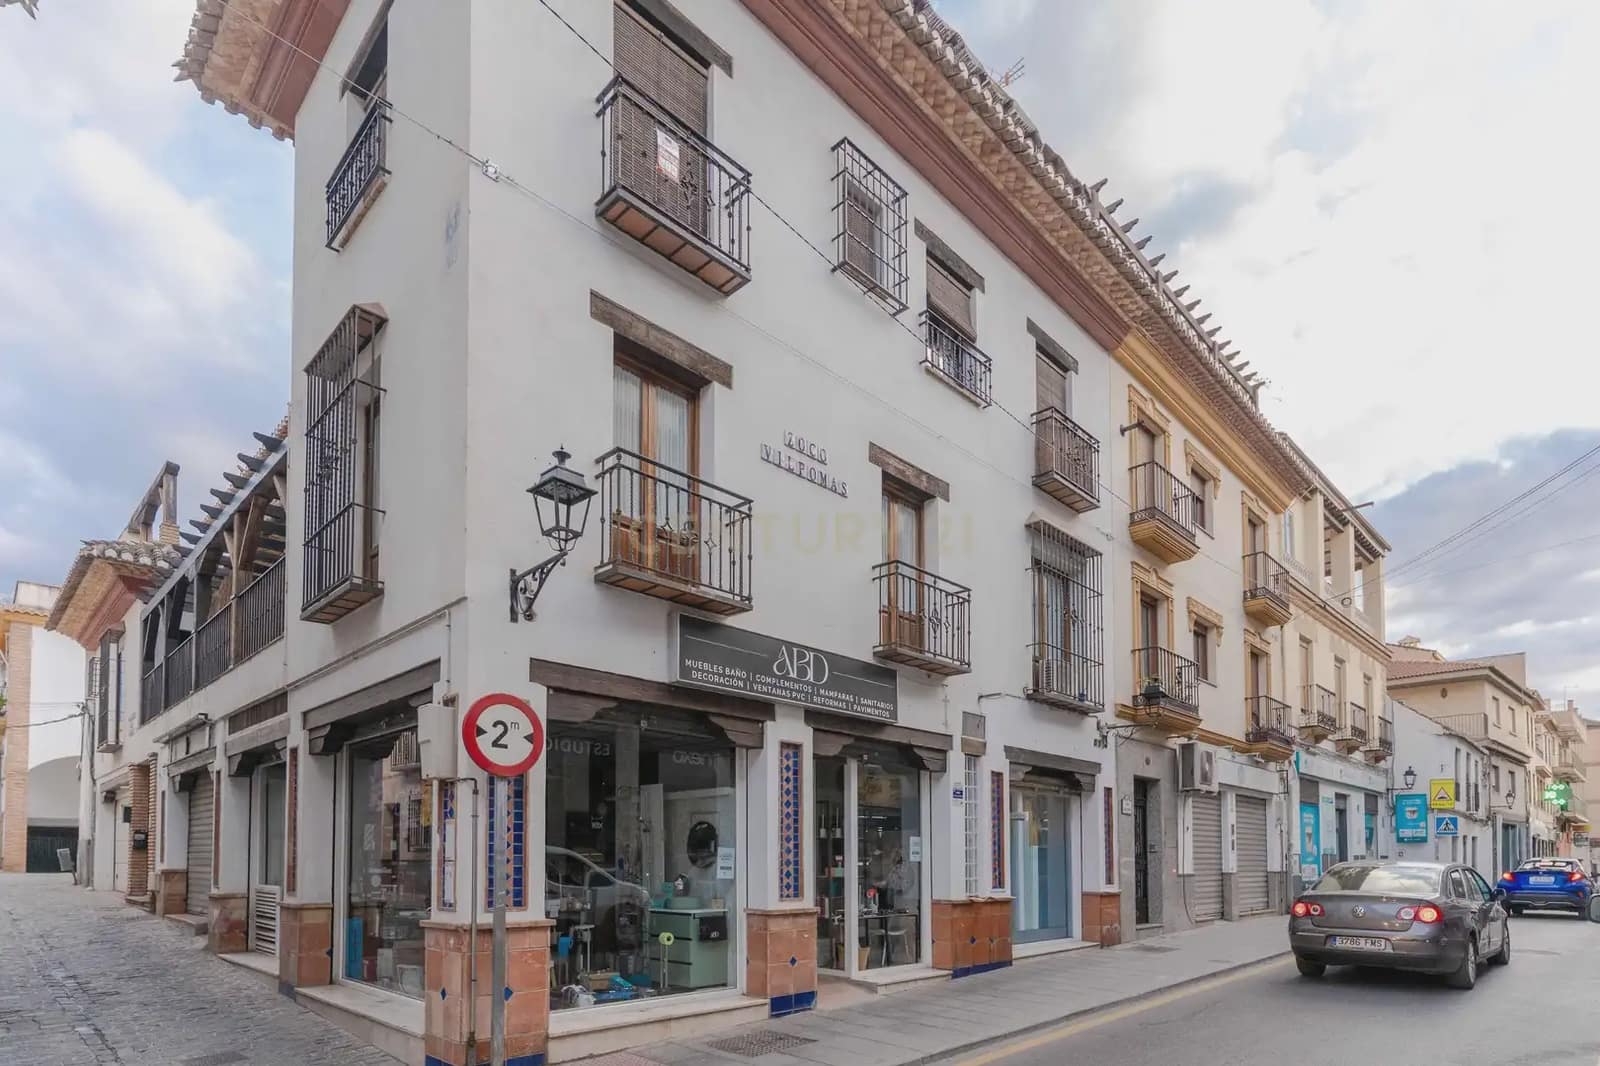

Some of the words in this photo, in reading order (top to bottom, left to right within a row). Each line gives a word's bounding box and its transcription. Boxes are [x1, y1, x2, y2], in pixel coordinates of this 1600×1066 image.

[787, 431, 827, 463] ZOCO
[685, 658, 723, 674] MUEBLES
[725, 667, 747, 679] BAÑO
[755, 674, 812, 693] COMPLEMENTOS
[819, 688, 854, 702] MAMPARAS
[860, 697, 894, 711] SANITARIOS
[772, 644, 829, 685] ABD
[691, 670, 743, 688] DECORACIÓN
[752, 682, 791, 698] VENTANAS
[792, 690, 806, 701] PVC
[813, 695, 847, 709] REFORMAS
[853, 704, 890, 718] PAVIMENTOS
